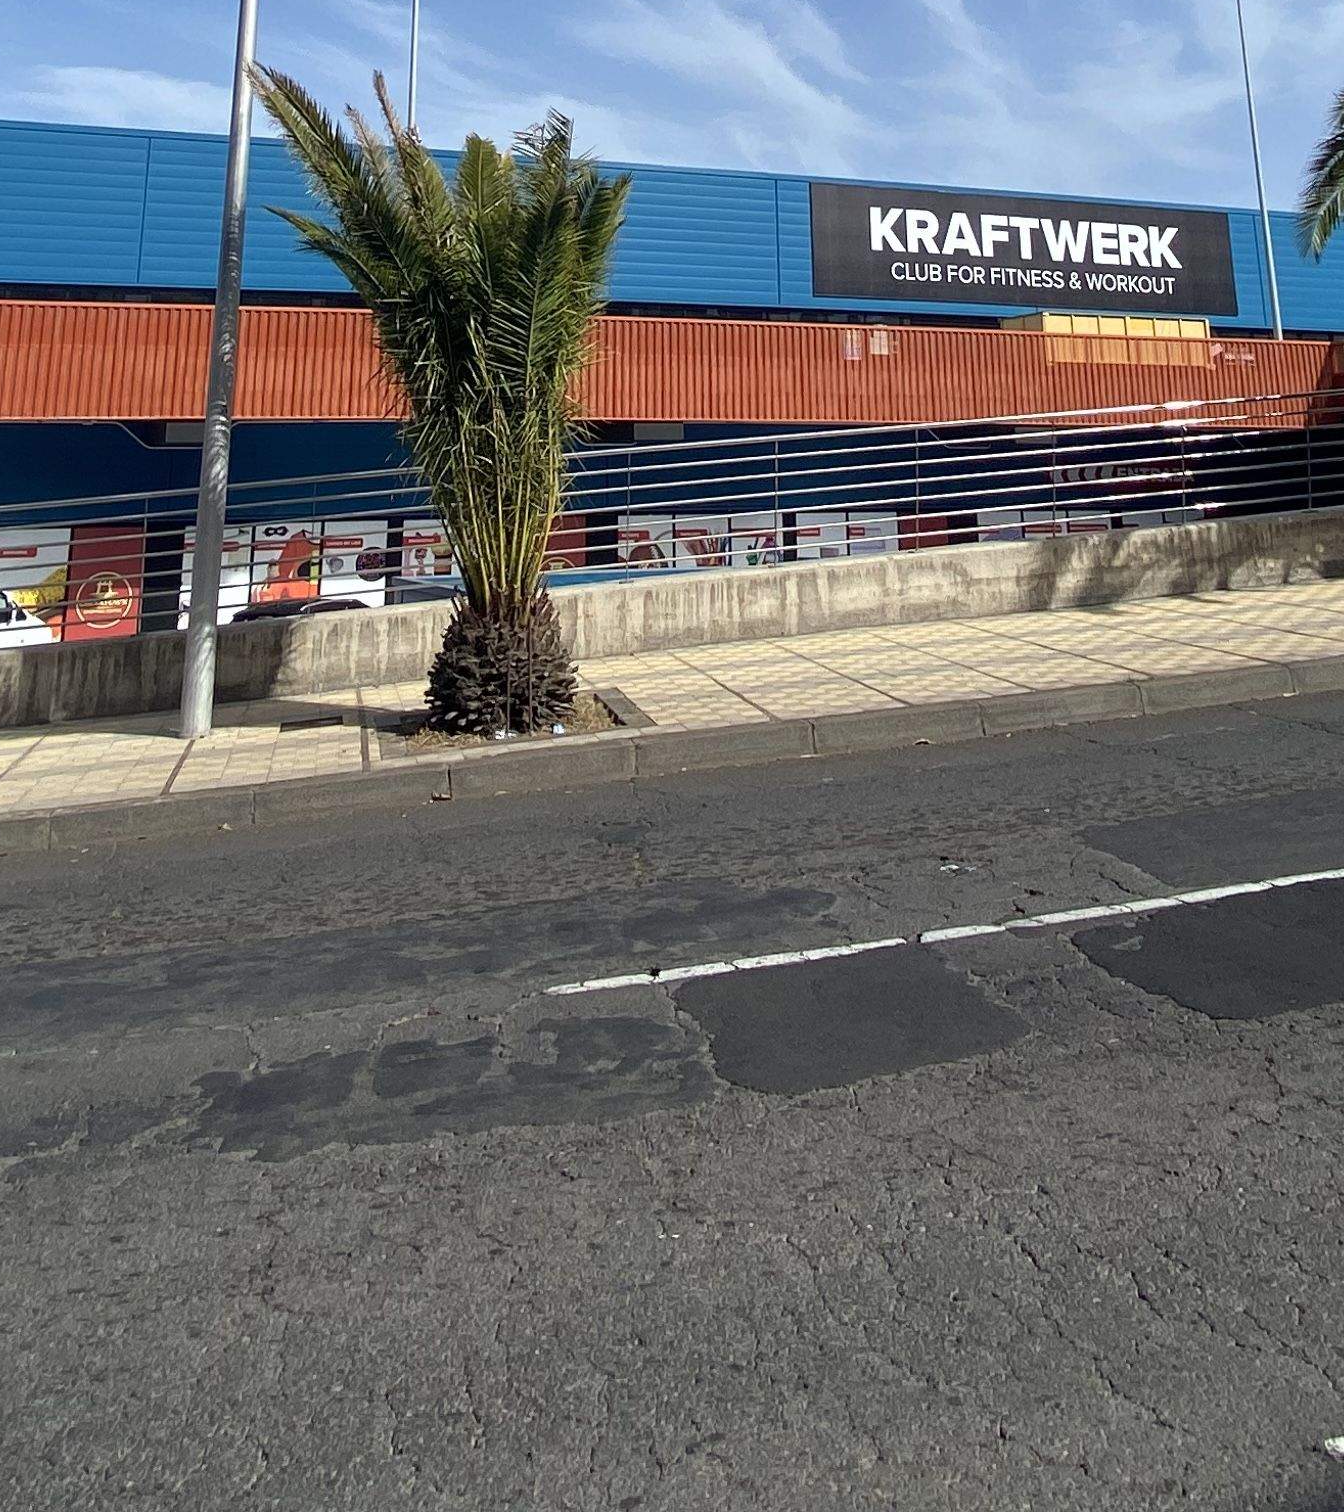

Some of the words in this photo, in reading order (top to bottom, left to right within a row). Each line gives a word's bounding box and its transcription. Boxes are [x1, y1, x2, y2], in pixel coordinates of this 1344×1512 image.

[869, 206, 1183, 269] KRAFTWERK
[890, 262, 943, 282] CLUB
[947, 264, 986, 285] FOR
[990, 267, 1065, 289] FITNESS
[1069, 271, 1082, 290] &
[1085, 273, 1176, 295] WORKOUT
